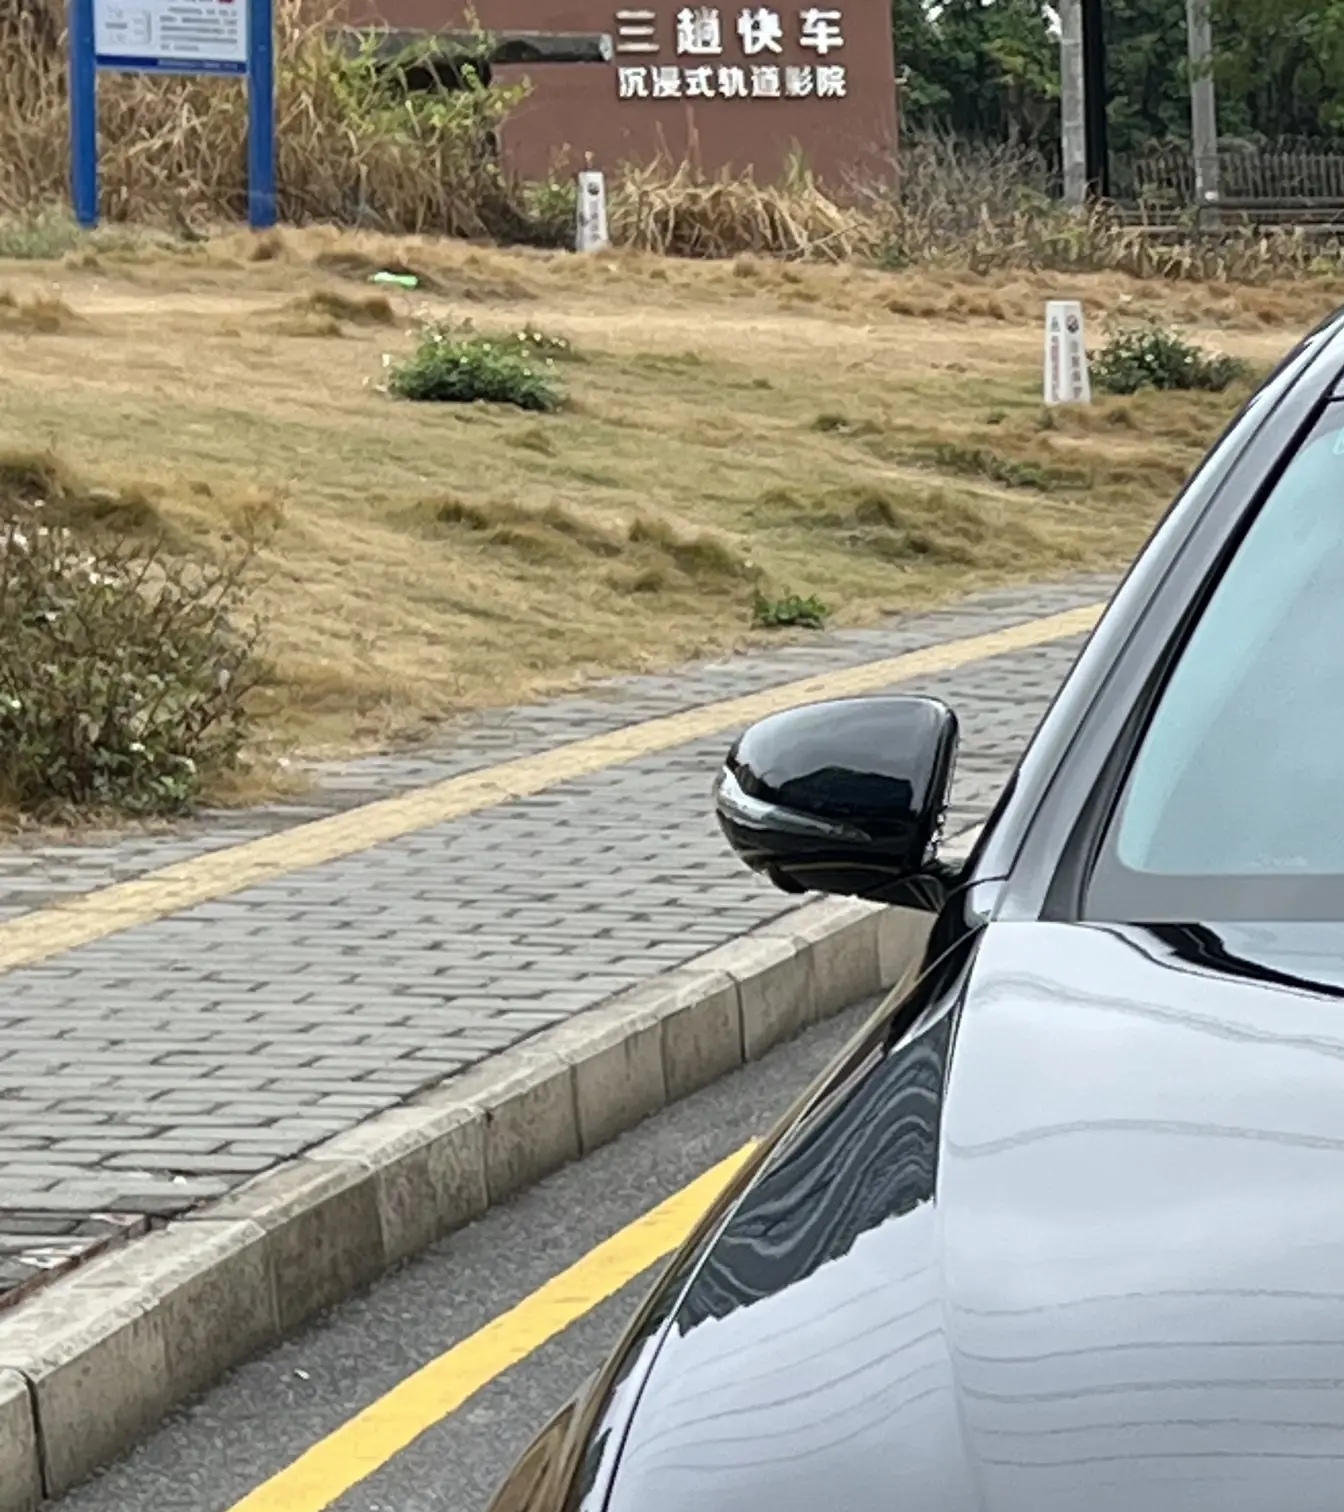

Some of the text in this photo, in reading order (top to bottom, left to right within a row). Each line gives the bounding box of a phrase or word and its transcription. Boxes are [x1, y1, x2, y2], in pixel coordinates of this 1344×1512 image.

[615, 7, 845, 55] 三趟快车
[618, 66, 847, 97] 沉浸式轨道影院
